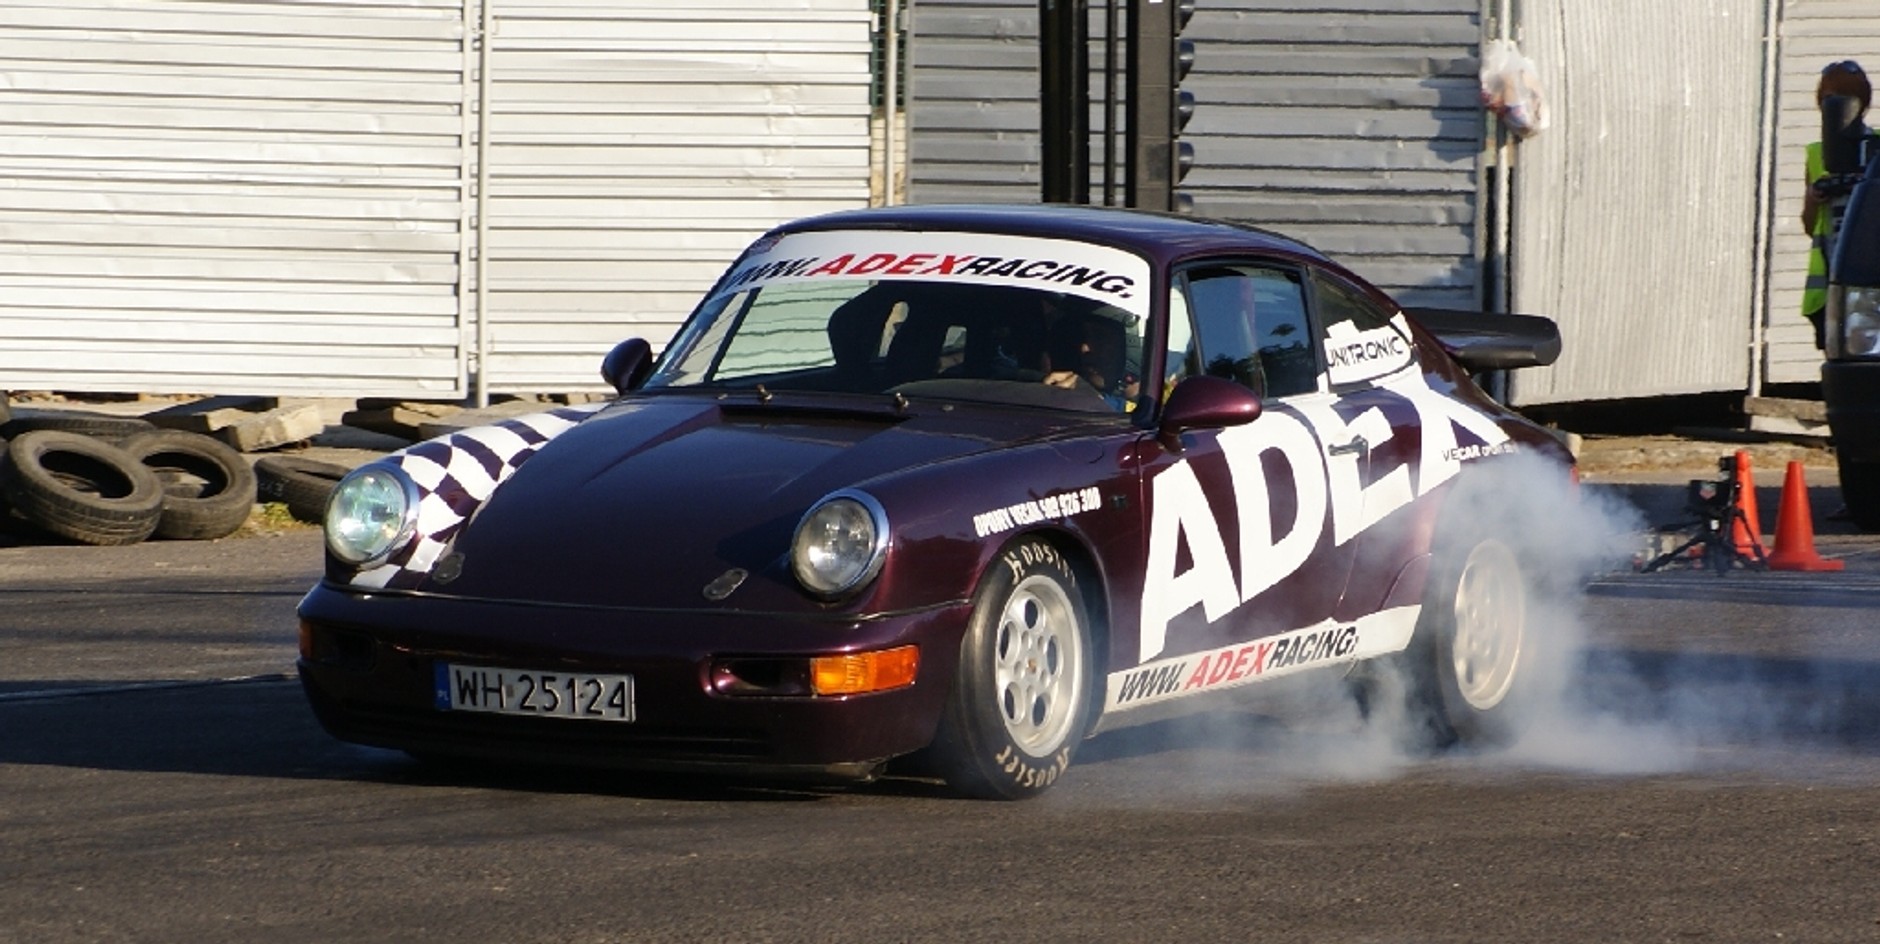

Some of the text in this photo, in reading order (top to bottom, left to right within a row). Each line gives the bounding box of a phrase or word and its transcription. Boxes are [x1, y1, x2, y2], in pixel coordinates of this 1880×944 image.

[1139, 325, 1509, 664] ADEX
[456, 669, 628, 718] WH 25124
